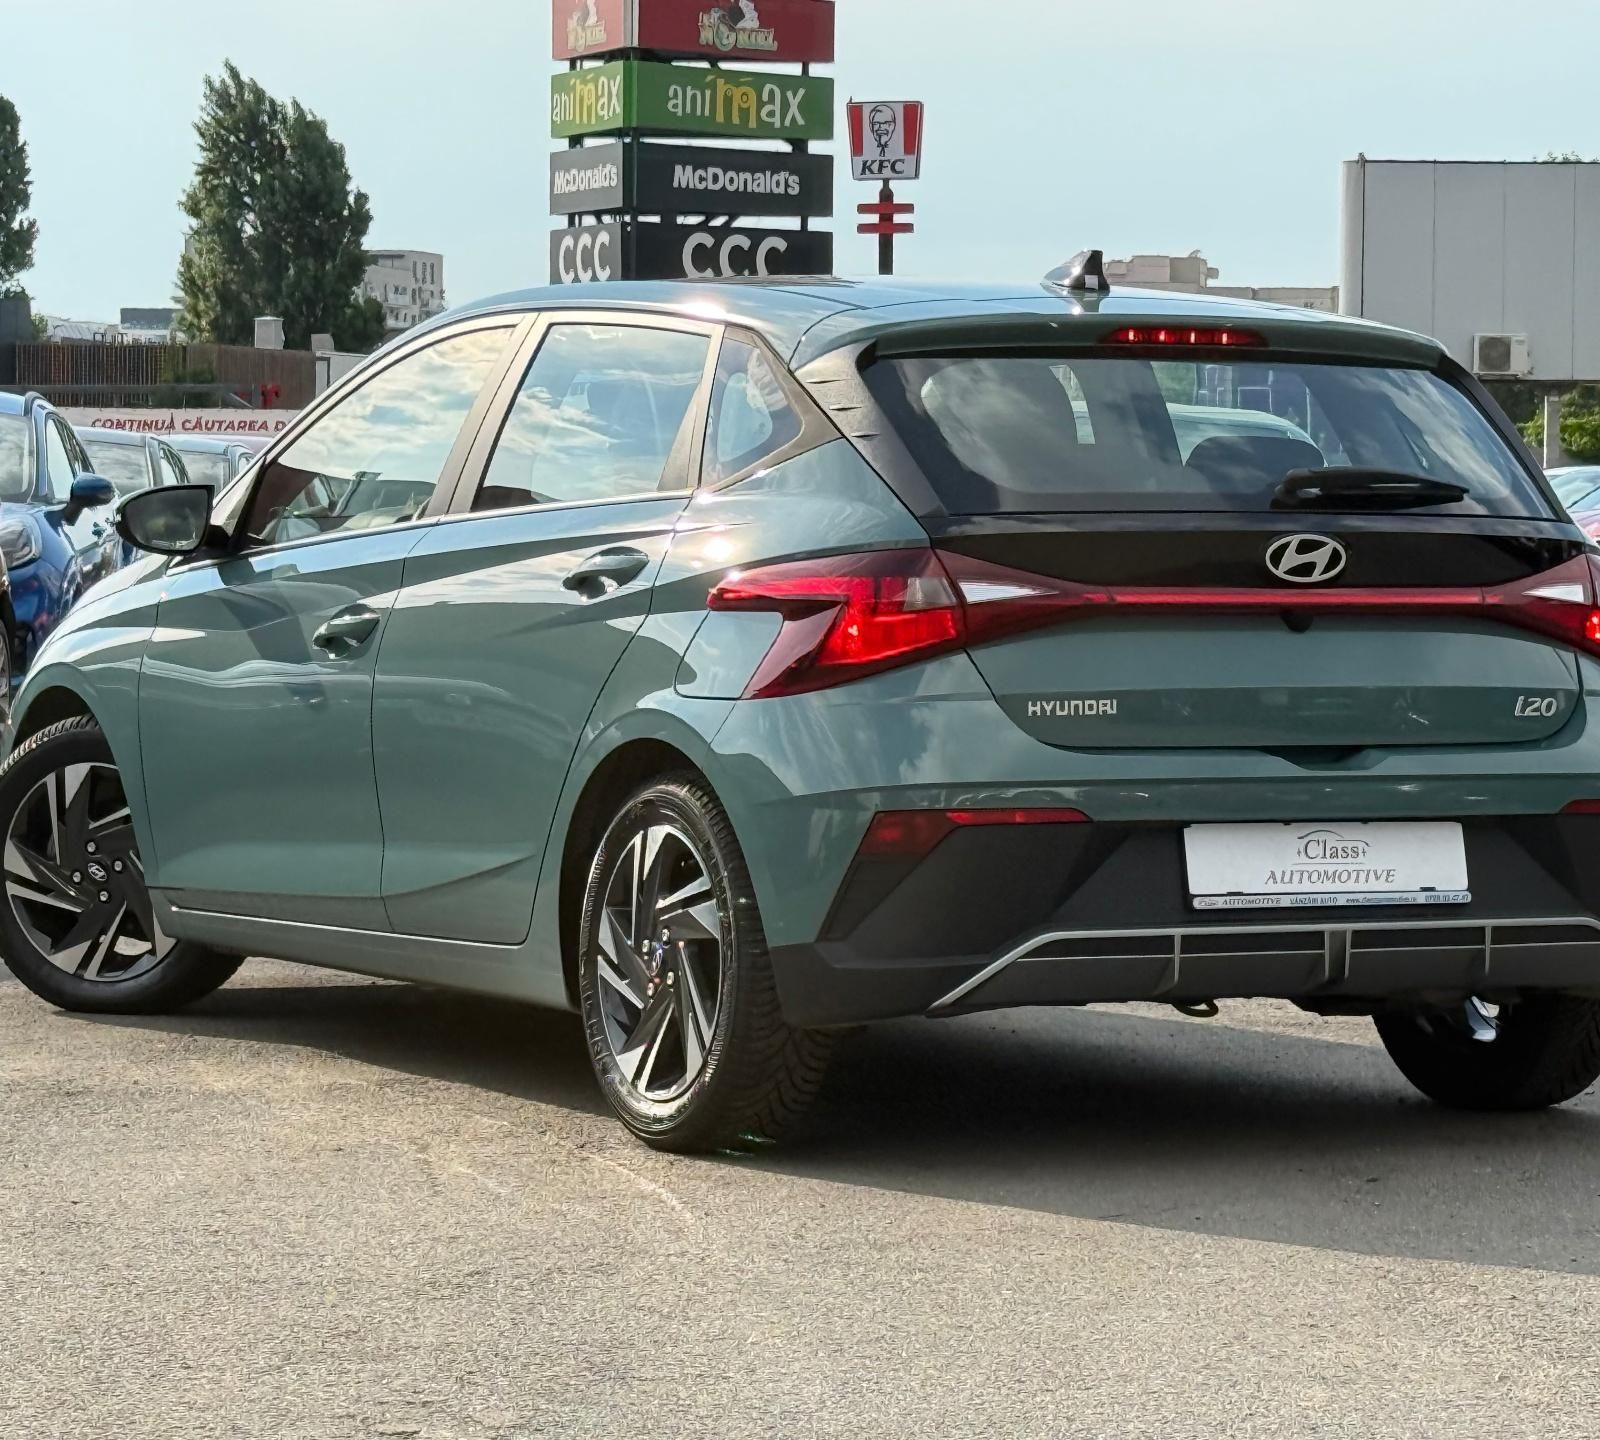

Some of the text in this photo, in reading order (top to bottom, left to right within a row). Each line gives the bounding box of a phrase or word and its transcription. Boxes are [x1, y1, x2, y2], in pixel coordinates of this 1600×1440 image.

[553, 73, 620, 124] animax
[667, 75, 806, 128] animax
[554, 163, 617, 194] McDonald's
[673, 164, 800, 195] McDonald's
[860, 158, 905, 175] KFC
[559, 230, 610, 284] CCC
[683, 232, 788, 278] CCC
[1028, 699, 1117, 716] HYUNDAI
[1515, 695, 1557, 717] i20
[1304, 839, 1359, 859] Class
[1264, 868, 1396, 885] AUTOMOTIVE
[1222, 897, 1282, 906] AUTOMOTIVE
